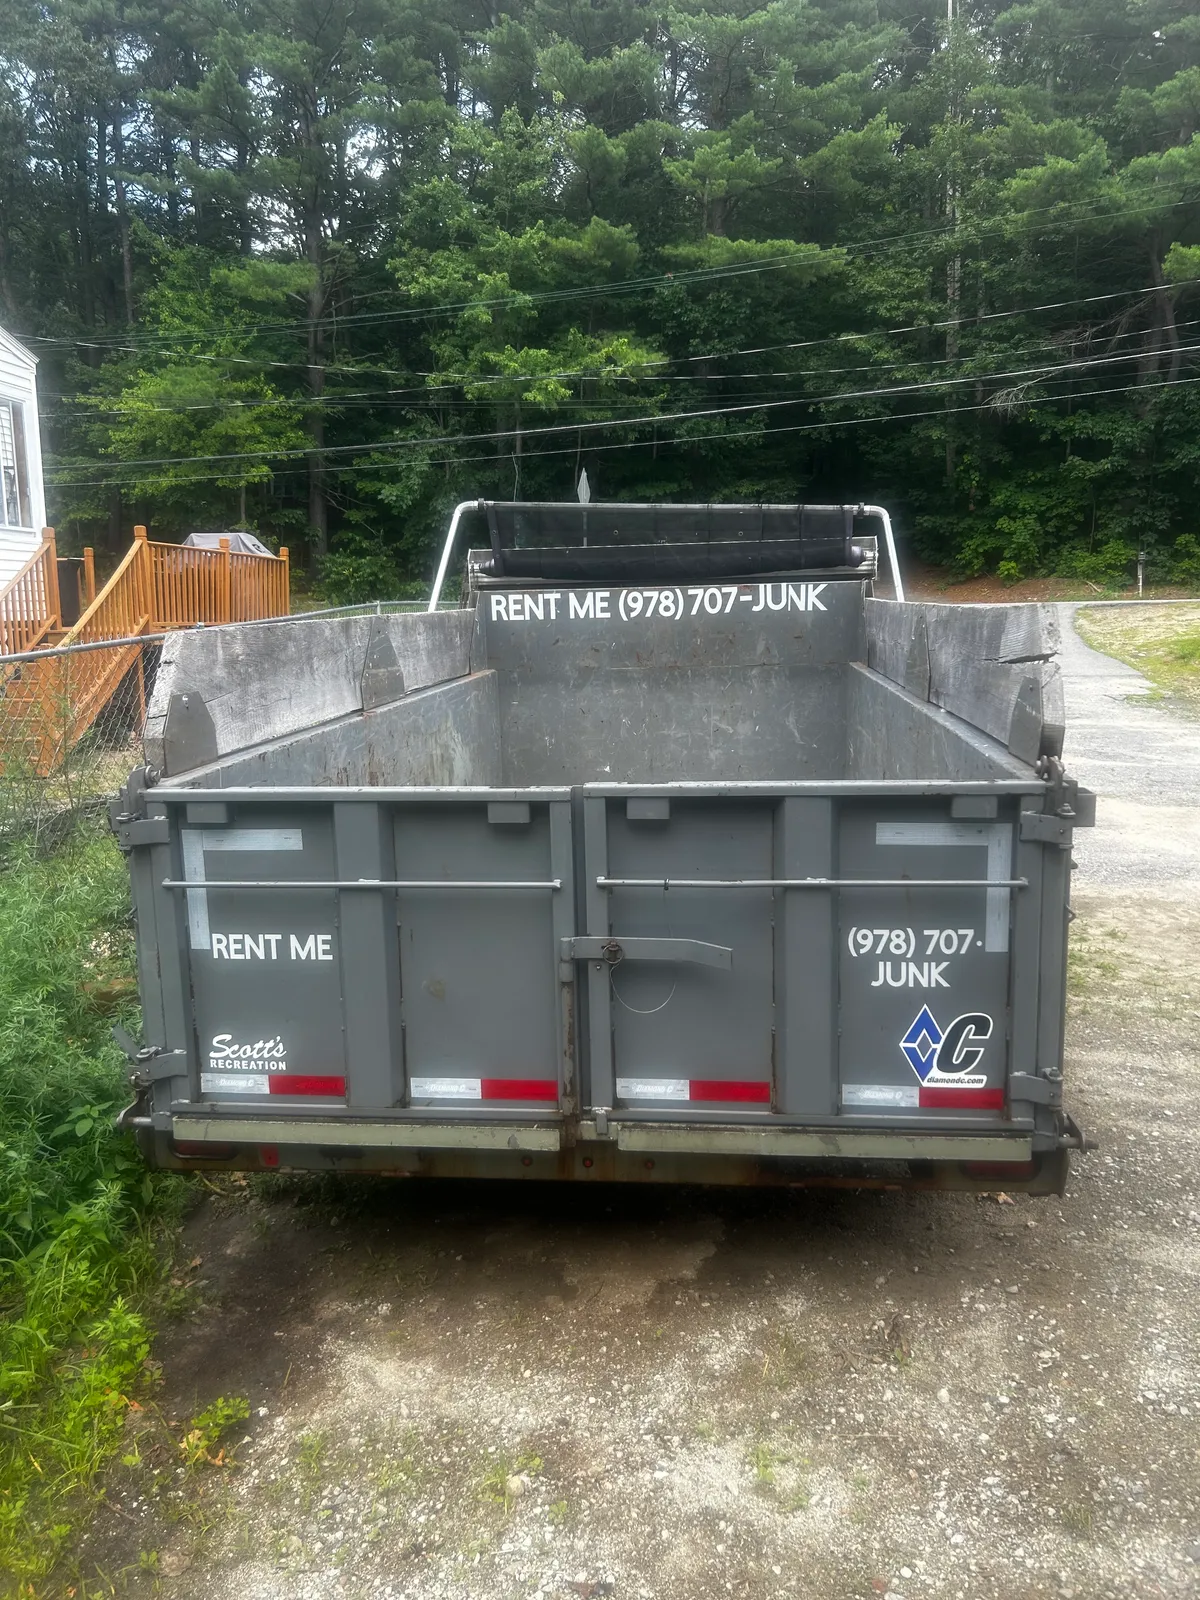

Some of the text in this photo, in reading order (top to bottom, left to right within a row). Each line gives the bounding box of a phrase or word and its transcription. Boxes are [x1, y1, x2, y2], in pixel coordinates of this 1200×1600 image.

[491, 593, 561, 621] RENT
[569, 592, 611, 619] ME
[618, 589, 684, 621] (978)
[212, 933, 333, 960] RENT ME
[848, 927, 916, 957] (978)
[871, 961, 951, 987] JUNK
[209, 1034, 287, 1058] Scott's
[210, 1059, 287, 1070] RECREATION
[926, 1076, 984, 1084] diamondc.com
